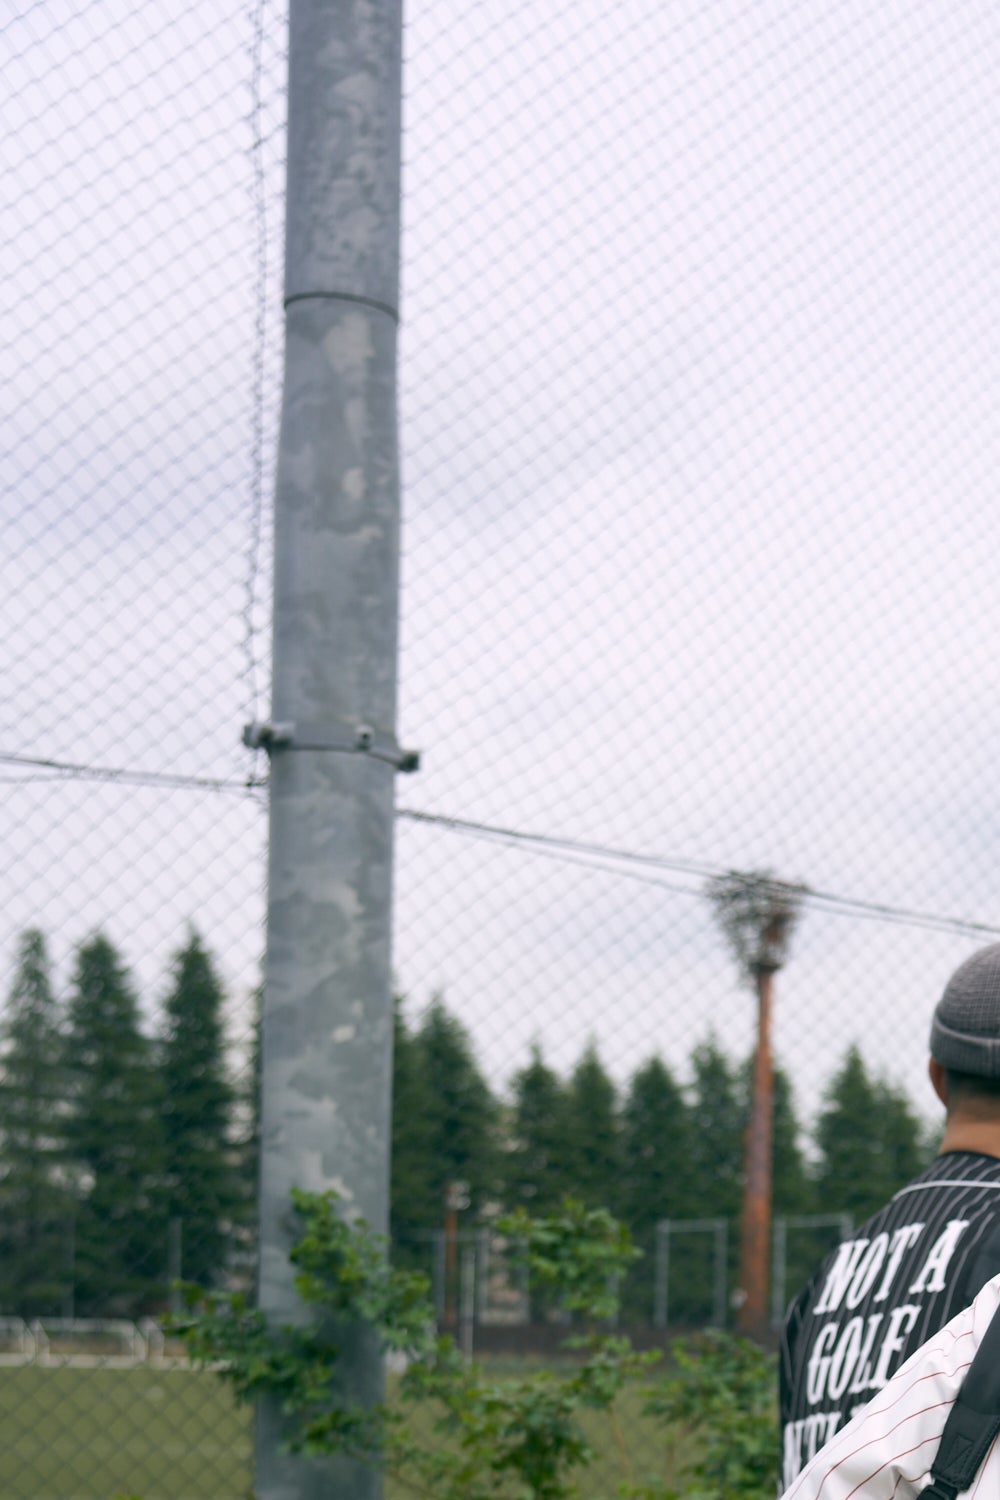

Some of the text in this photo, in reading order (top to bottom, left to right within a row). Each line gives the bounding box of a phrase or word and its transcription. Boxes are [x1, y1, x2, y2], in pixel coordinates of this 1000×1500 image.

[813, 1219, 970, 1315] NOT A
[807, 1305, 922, 1405] GOLF
